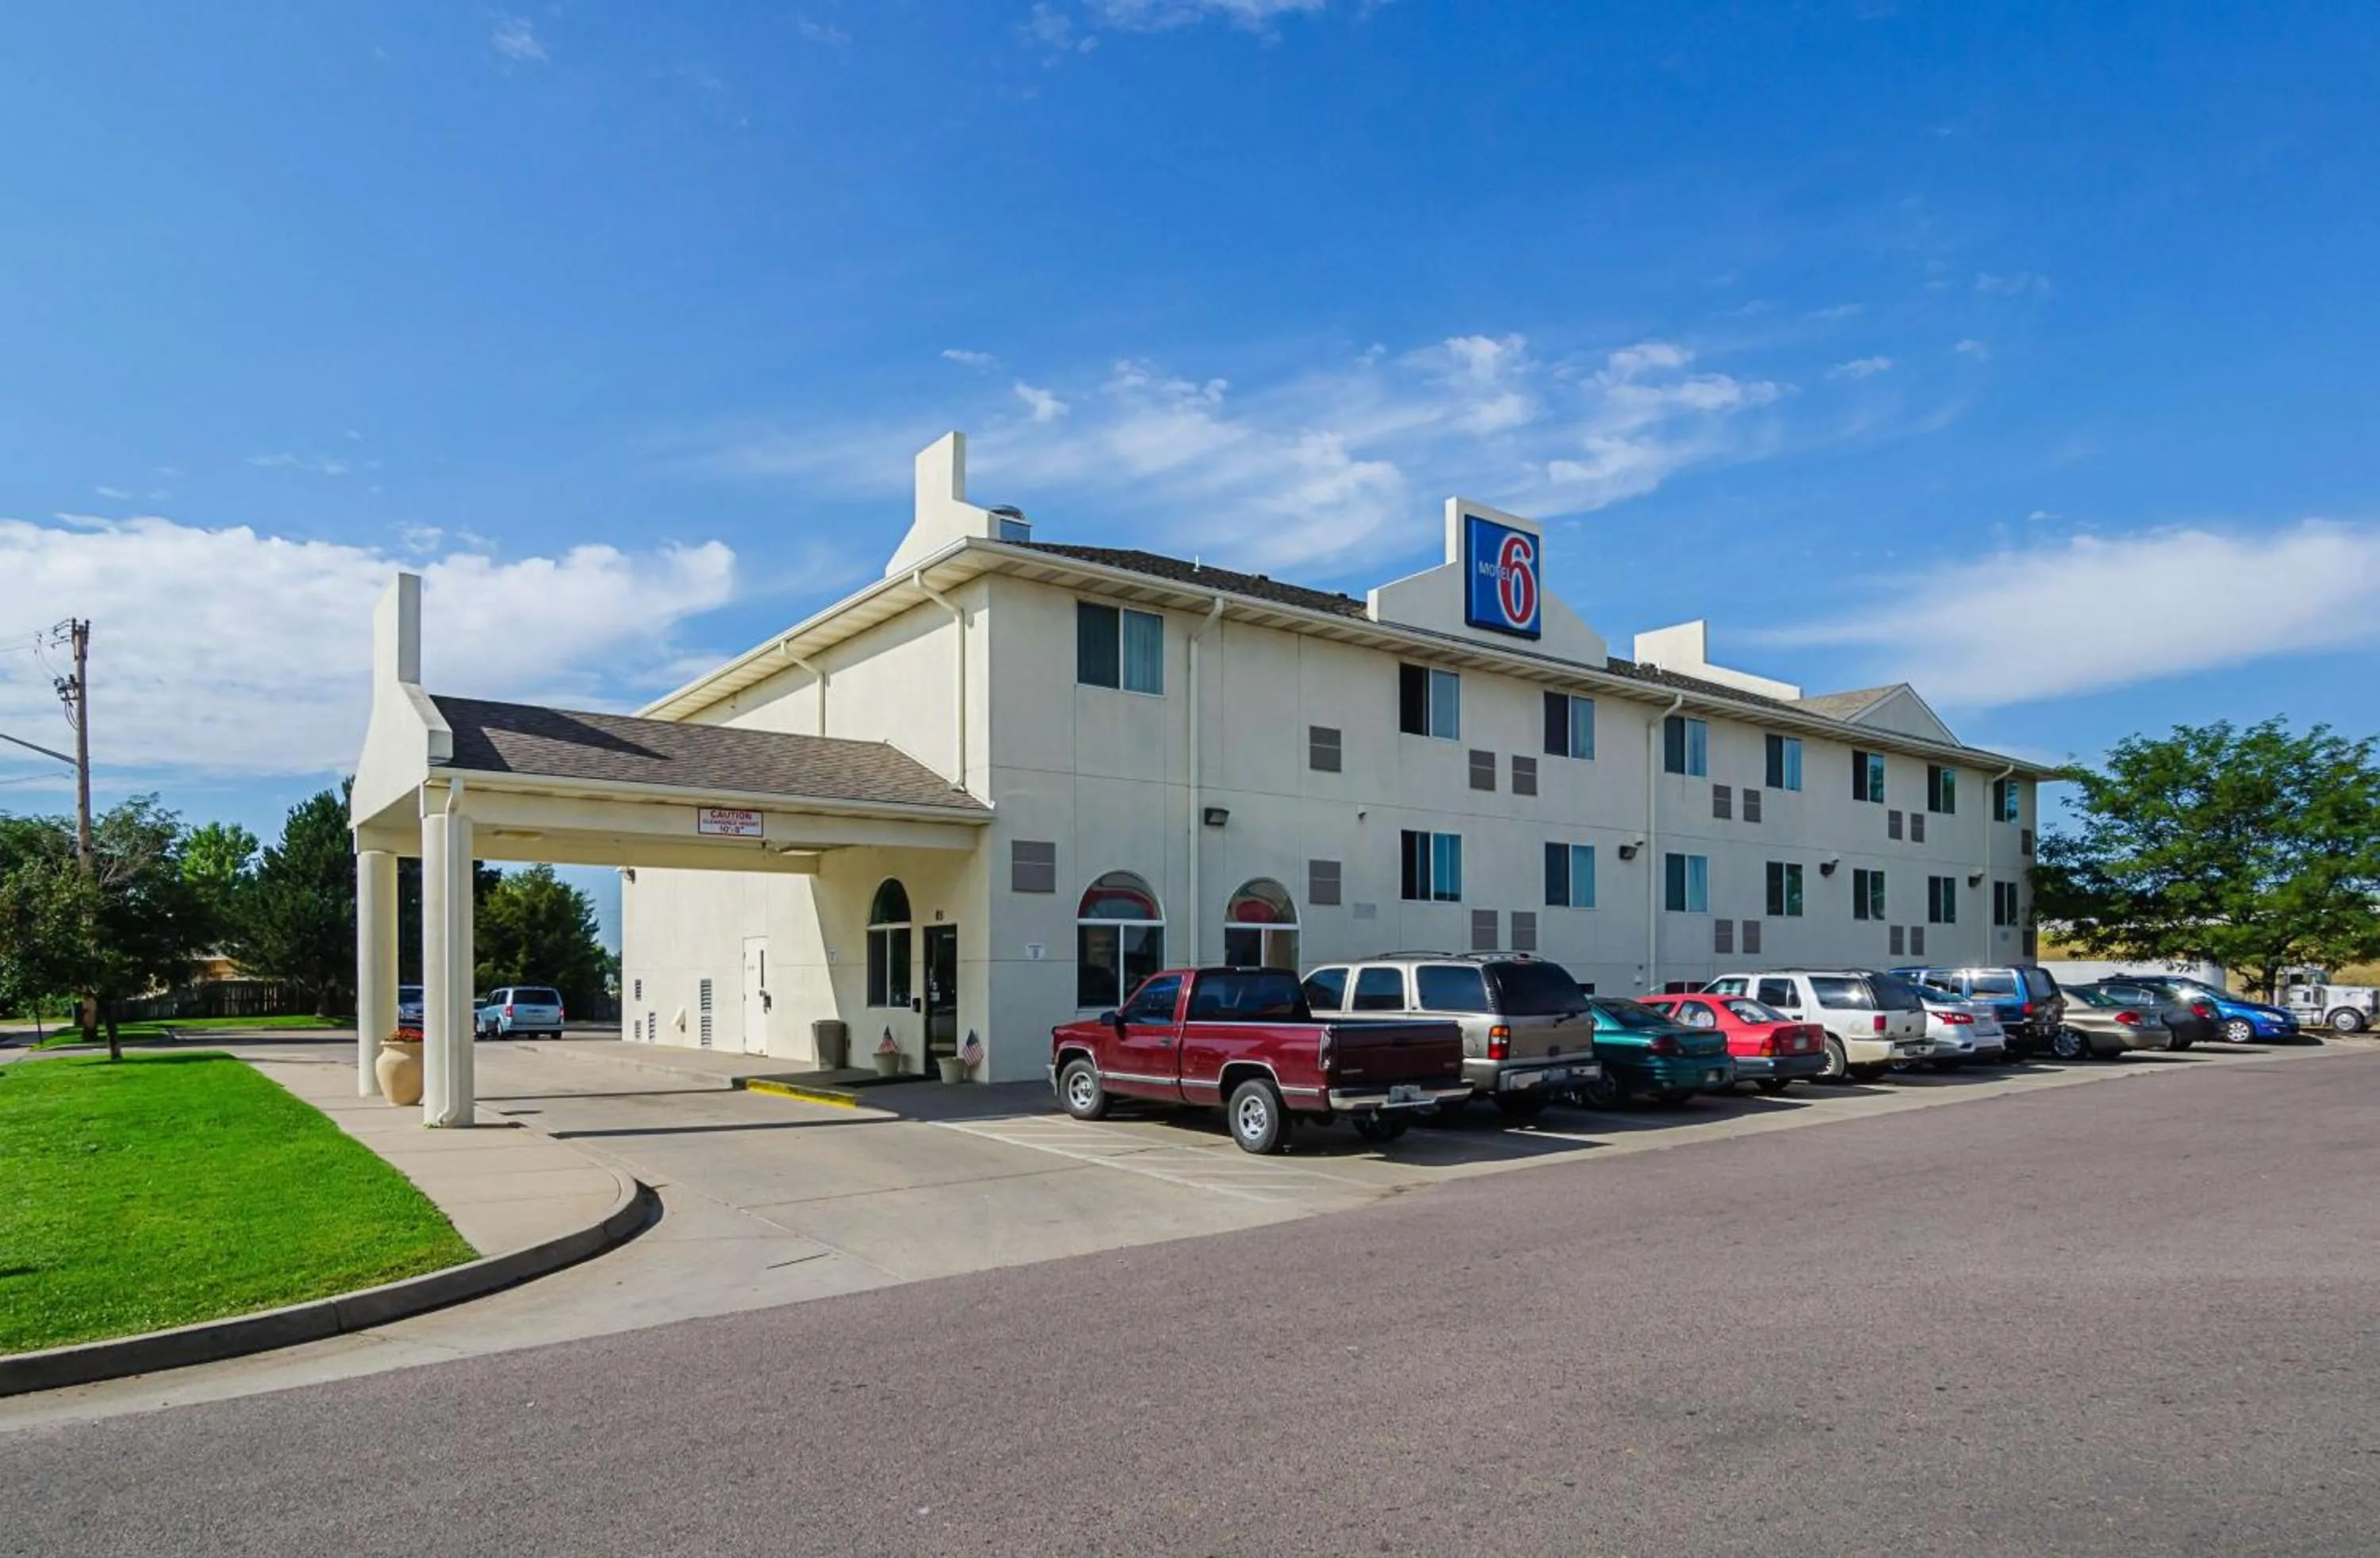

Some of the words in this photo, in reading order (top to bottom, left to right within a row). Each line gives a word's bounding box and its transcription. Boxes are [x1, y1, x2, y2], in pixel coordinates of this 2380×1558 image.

[1479, 560, 1511, 581] MOTEL
[1499, 532, 1537, 629] 6
[710, 810, 752, 820] CAUTION
